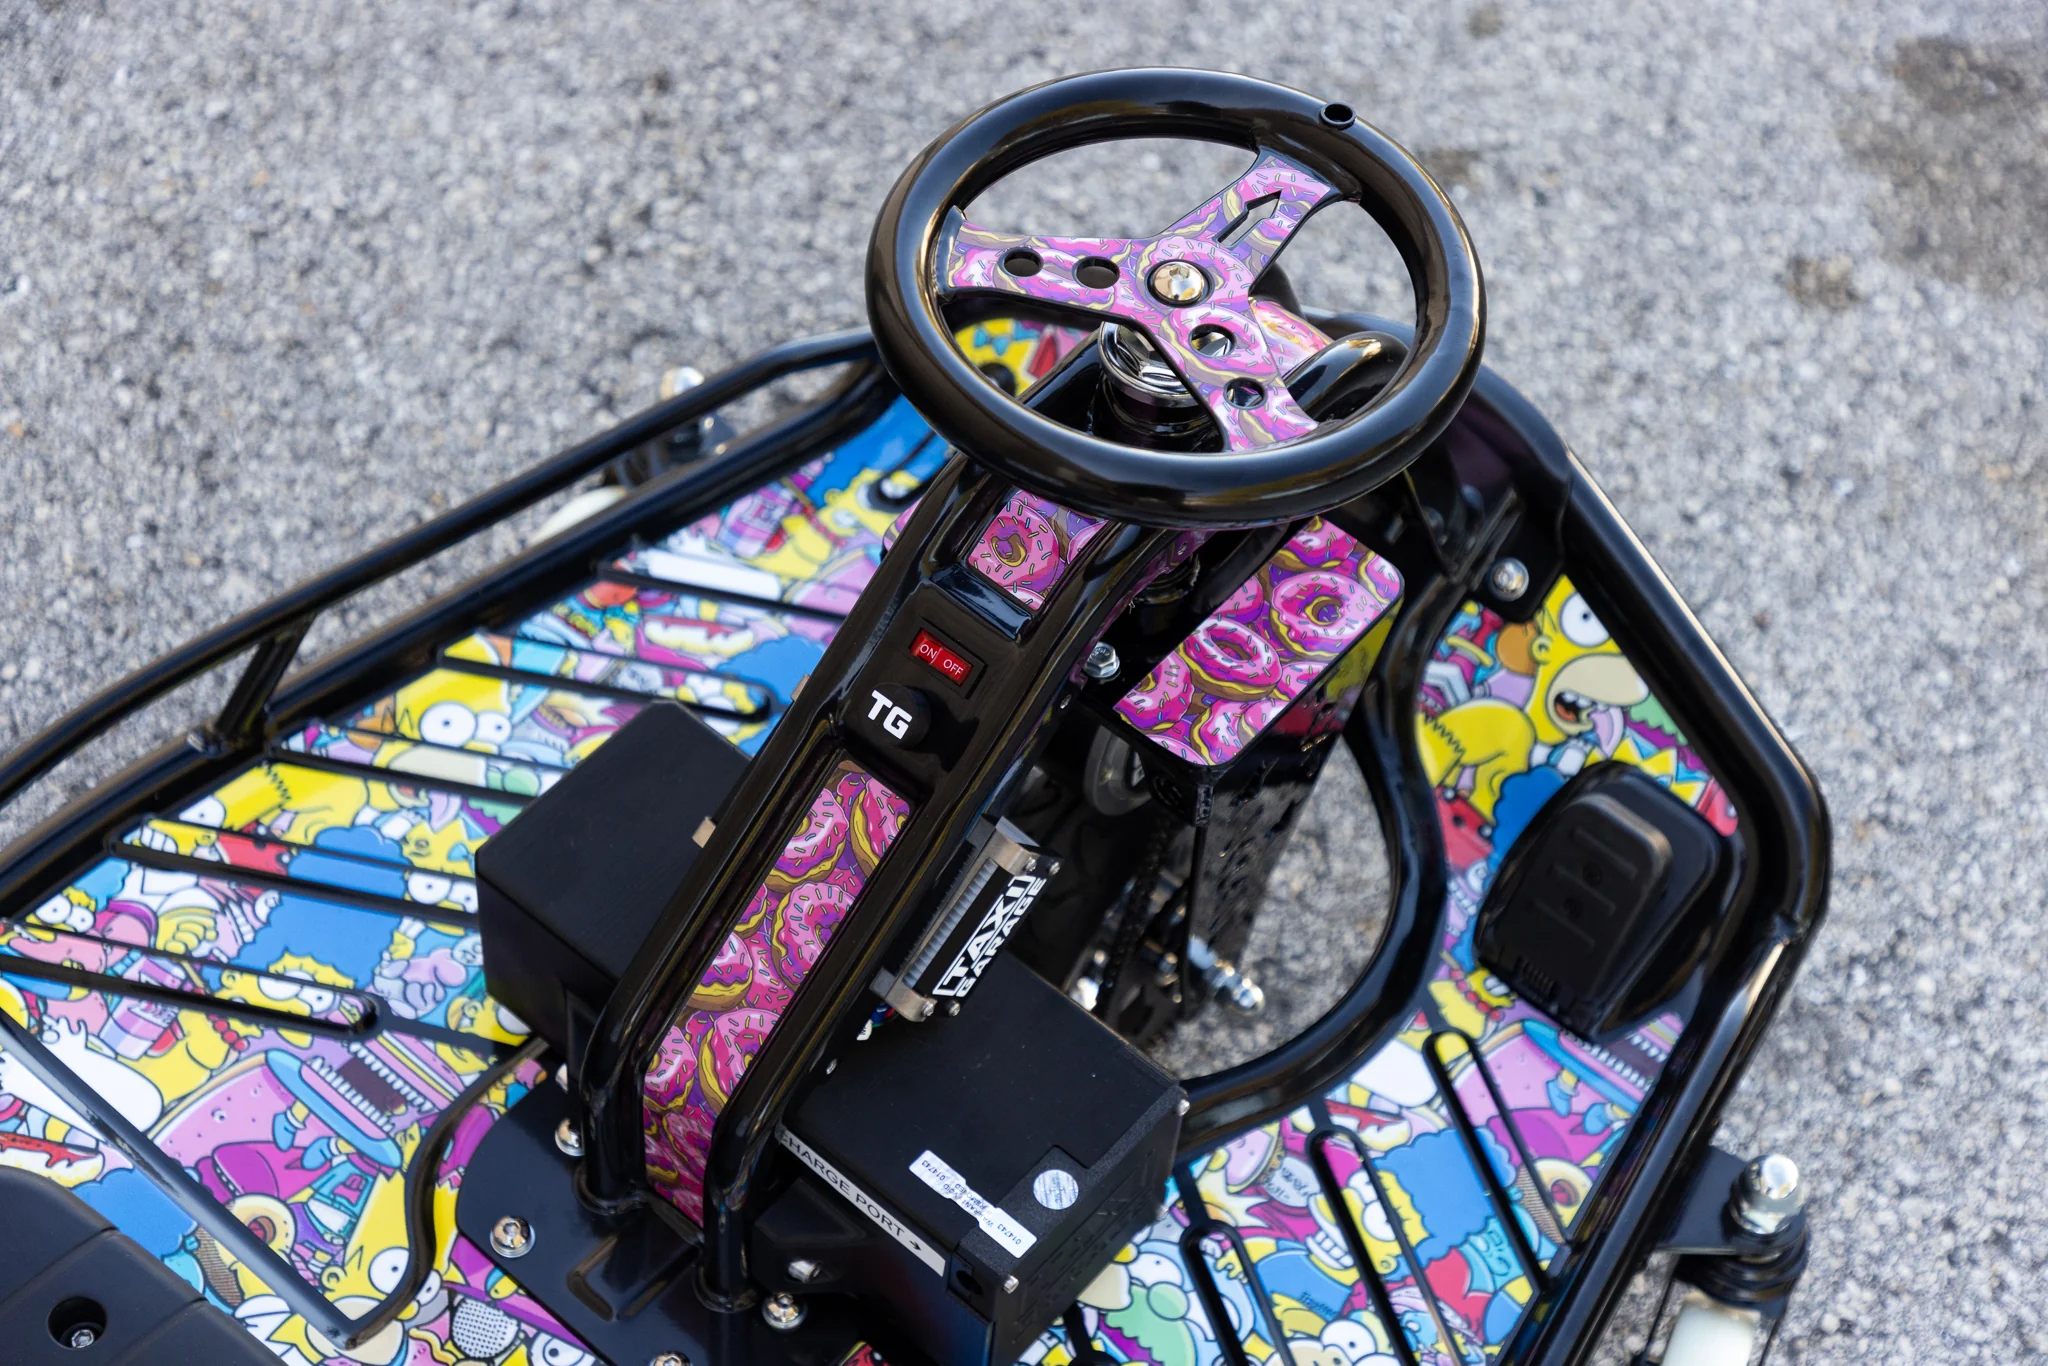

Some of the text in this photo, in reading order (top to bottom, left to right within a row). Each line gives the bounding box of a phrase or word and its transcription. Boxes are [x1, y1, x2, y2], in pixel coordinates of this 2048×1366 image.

[919, 644, 964, 676] ON OFF
[867, 690, 913, 740] TG
[942, 883, 1027, 987] TAXI
[955, 877, 1047, 998] GARAGE
[855, 1193, 905, 1237] PORT
[997, 1223, 1022, 1245] 014743
